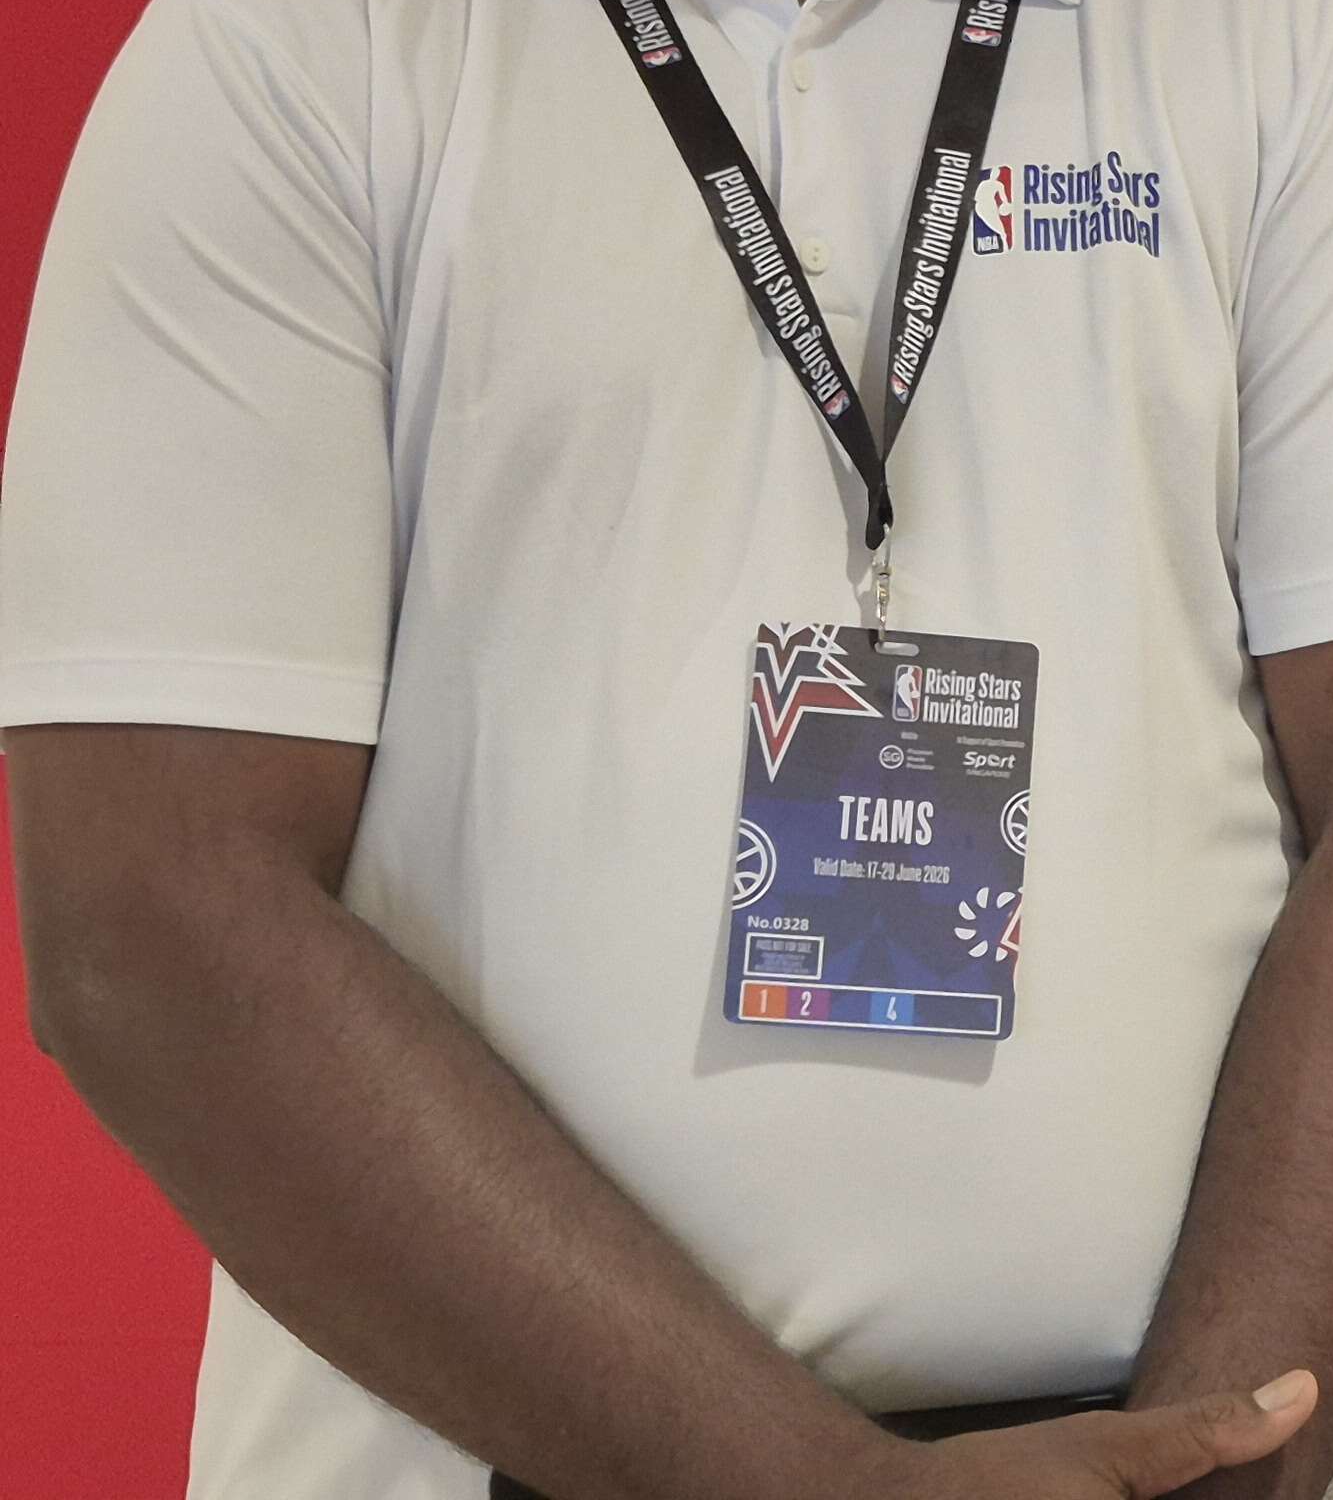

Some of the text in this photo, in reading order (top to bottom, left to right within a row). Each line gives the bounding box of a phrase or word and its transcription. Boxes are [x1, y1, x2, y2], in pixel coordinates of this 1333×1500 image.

[1023, 161, 1103, 207] Rising
[704, 165, 842, 402] Rising Stars Invitational
[894, 148, 972, 385] Rising Stars Invitational
[924, 668, 1022, 702] Rising Stars
[922, 696, 1020, 729] Invitational
[963, 751, 1016, 768] Sport
[838, 795, 934, 846] TEAMS
[759, 989, 768, 1013] 1
[800, 991, 812, 1016] 2
